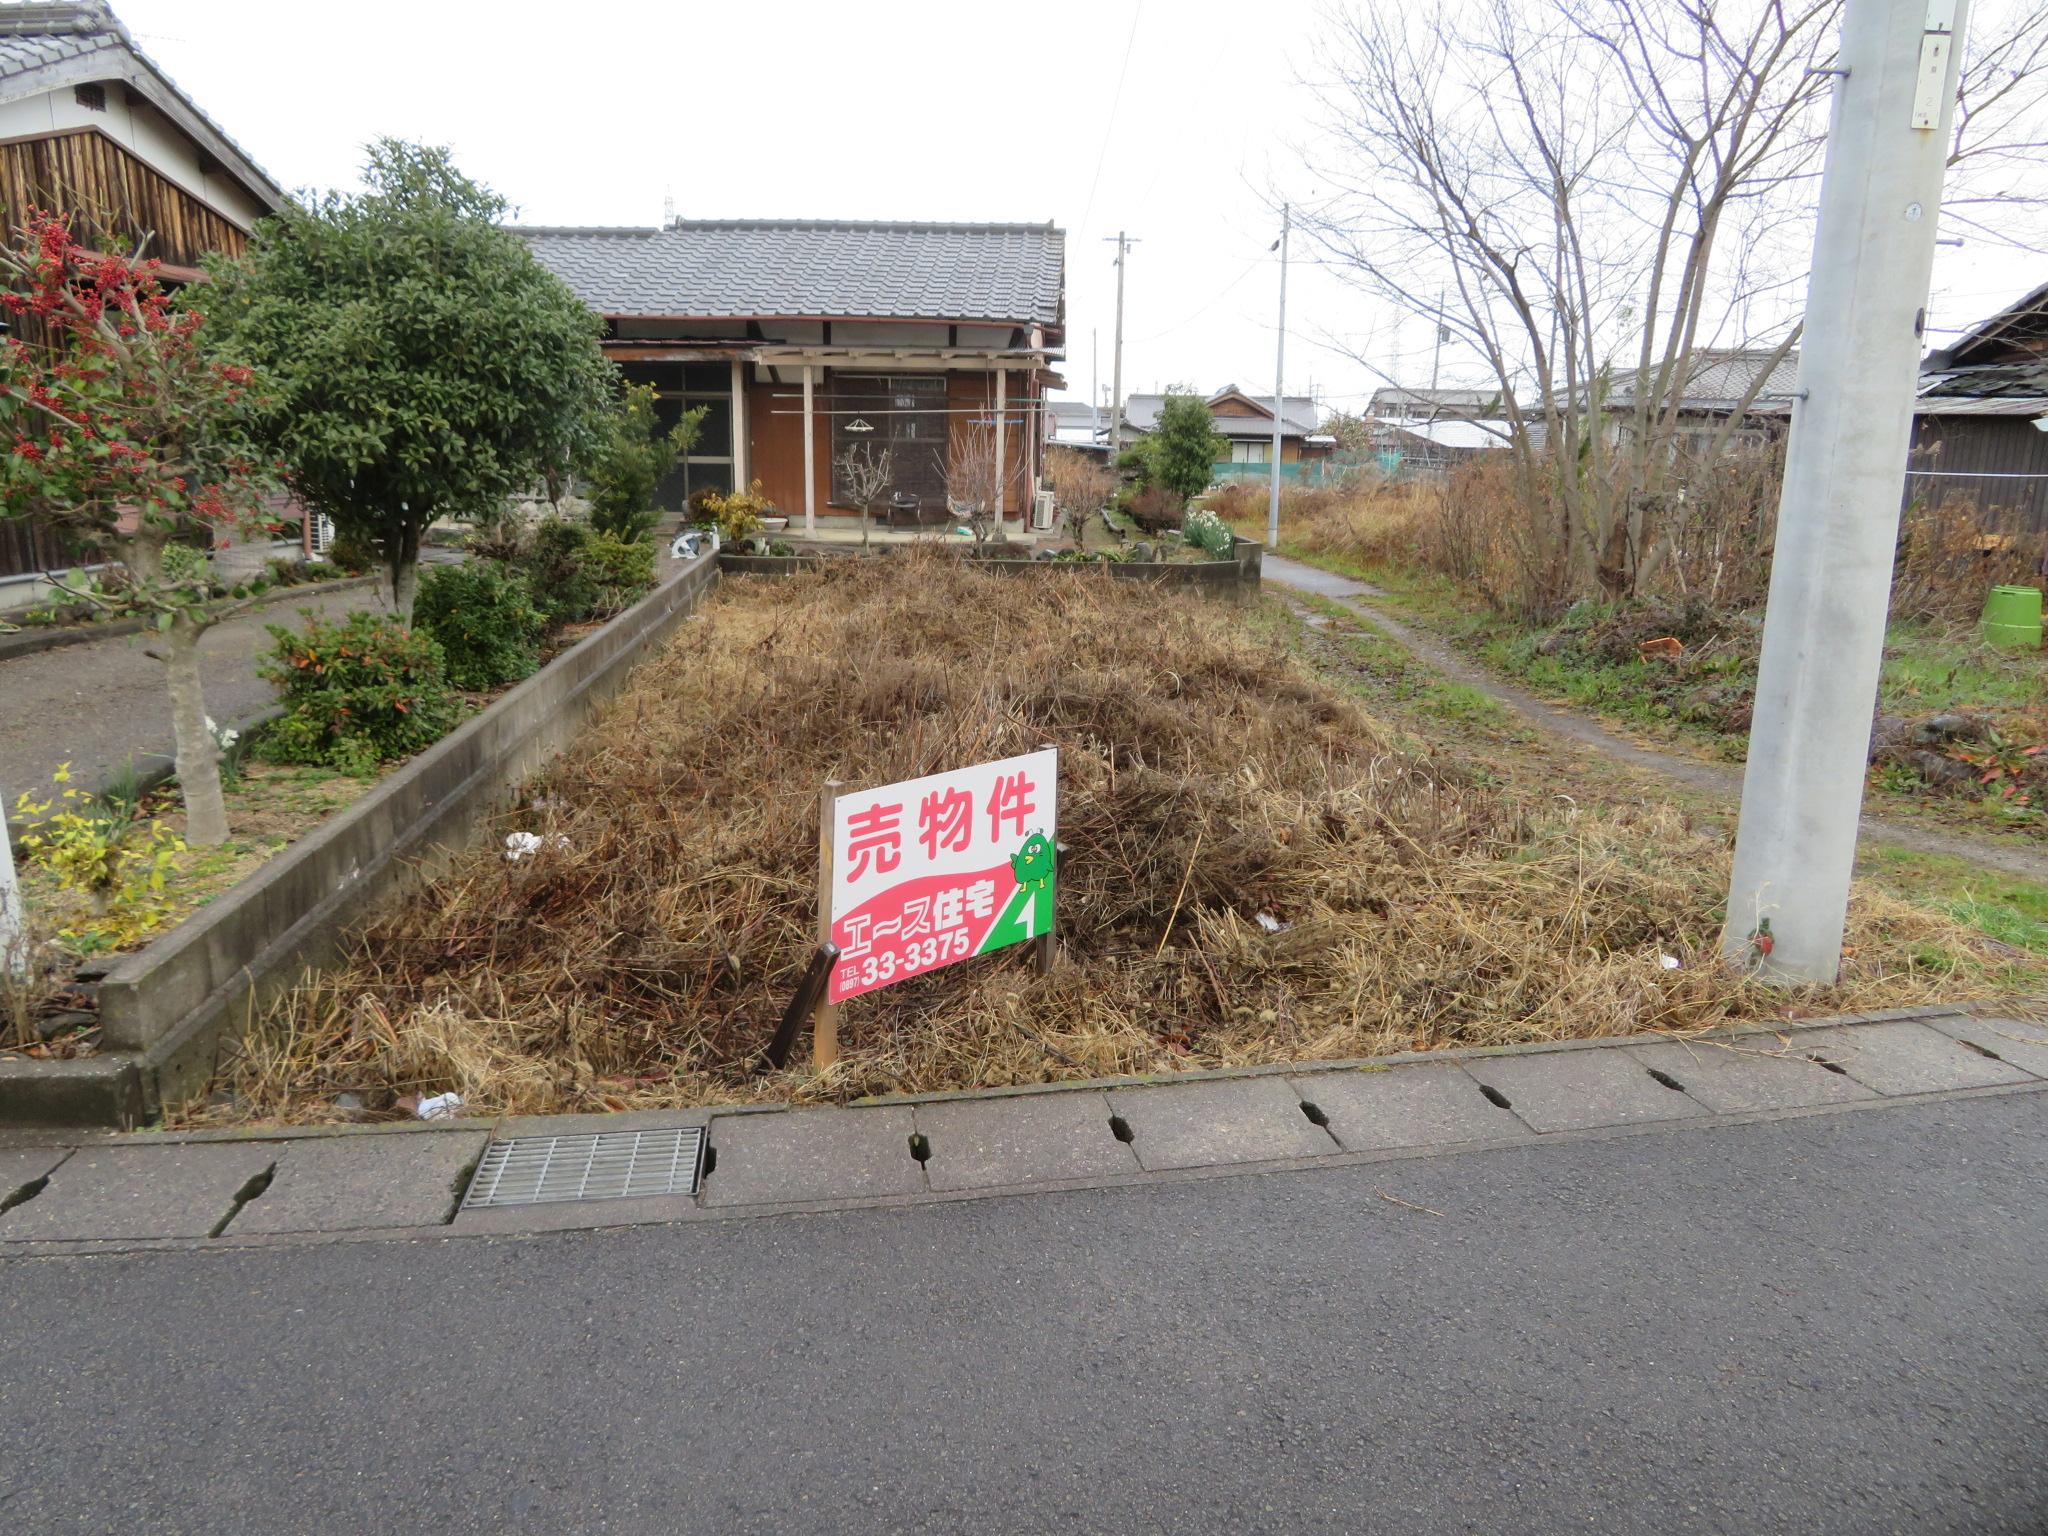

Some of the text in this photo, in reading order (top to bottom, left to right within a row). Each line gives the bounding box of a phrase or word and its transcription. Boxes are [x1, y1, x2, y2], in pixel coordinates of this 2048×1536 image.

[847, 771, 1036, 884] 売物件
[840, 878, 995, 962] エース住宅
[839, 928, 970, 993] (0897) 33-3375
[840, 965, 860, 980] TEL
